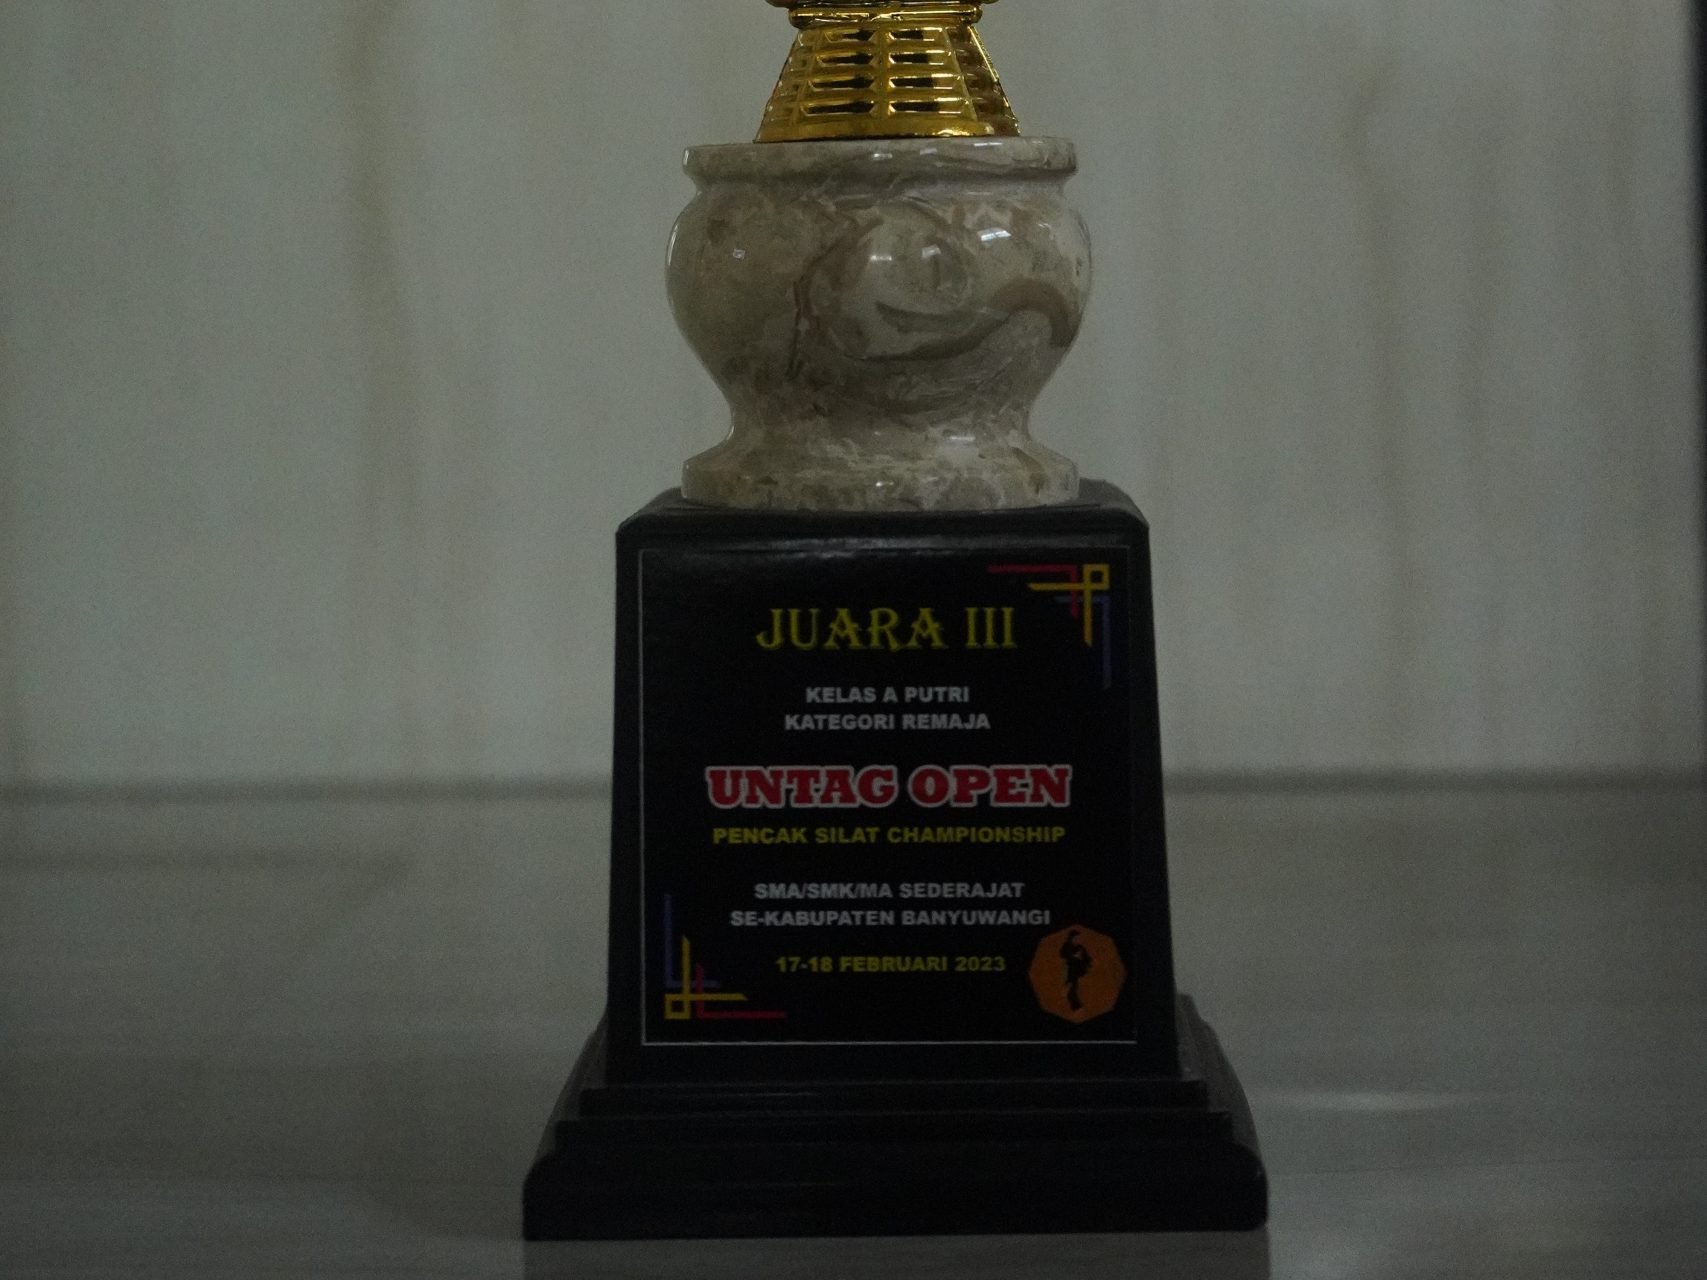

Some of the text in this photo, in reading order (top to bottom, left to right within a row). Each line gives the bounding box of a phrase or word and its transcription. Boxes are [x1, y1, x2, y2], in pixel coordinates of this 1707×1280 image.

[755, 606, 1017, 652] JUARA III
[806, 686, 969, 703] KELAS A PUTRI
[785, 713, 990, 730] KATEGORI REMAJA
[706, 764, 1072, 808] UNTAG OPEN
[713, 826, 1065, 844] PENCAK SILAT CHAMPIONSHIP
[754, 882, 1024, 899] SMA/SMK/MA SEDERAJAT
[731, 909, 1050, 926] SE-KABUPATEN BANYUWANGI
[776, 956, 1006, 972] 17-18 FEBRUARI 2023
